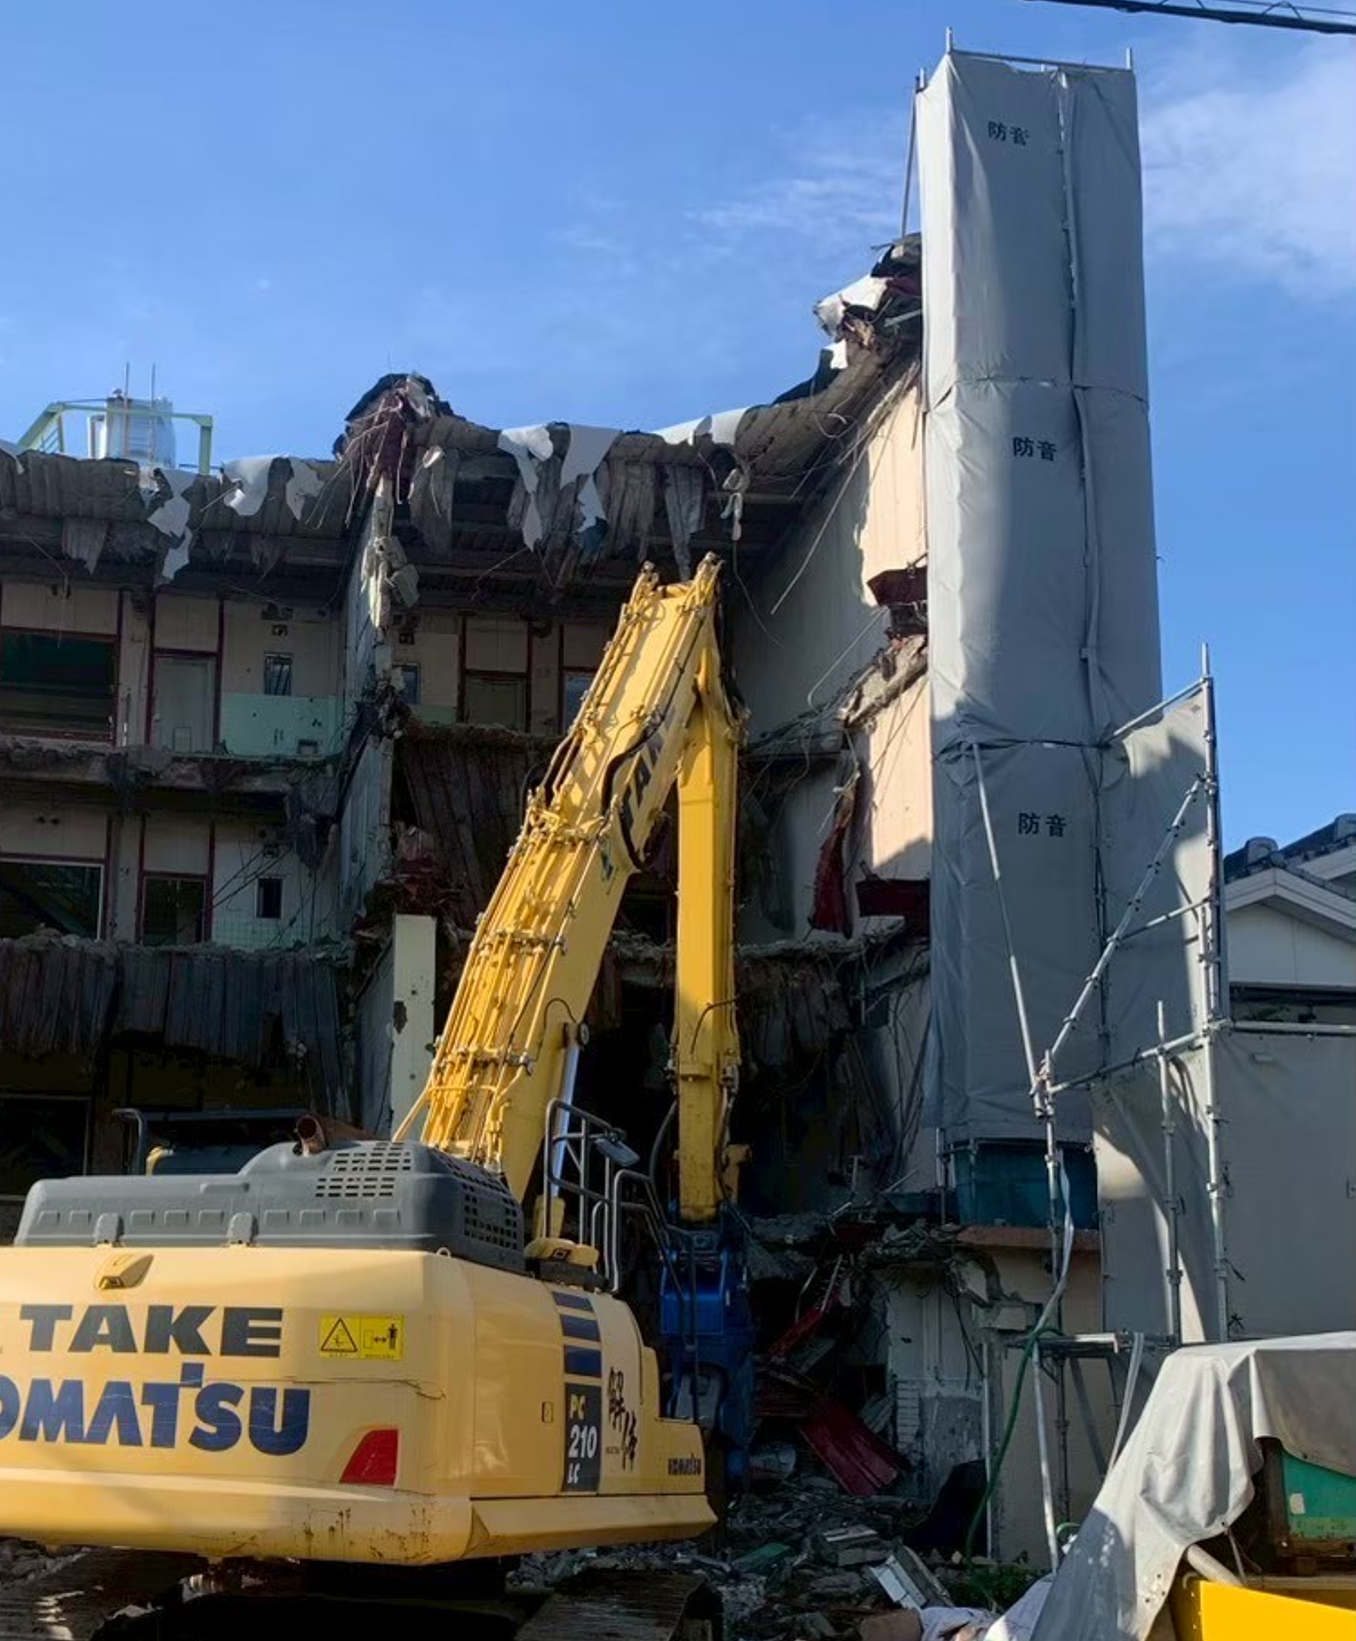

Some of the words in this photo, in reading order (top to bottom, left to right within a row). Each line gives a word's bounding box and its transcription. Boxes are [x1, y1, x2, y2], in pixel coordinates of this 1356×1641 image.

[988, 121, 1029, 146] 防音
[1013, 436, 1057, 461] 防音
[1019, 813, 1067, 837] 防音
[19, 1304, 284, 1358] TAKE
[569, 1393, 586, 1420] PC
[568, 1424, 598, 1458] 210
[567, 1463, 581, 1484] LC
